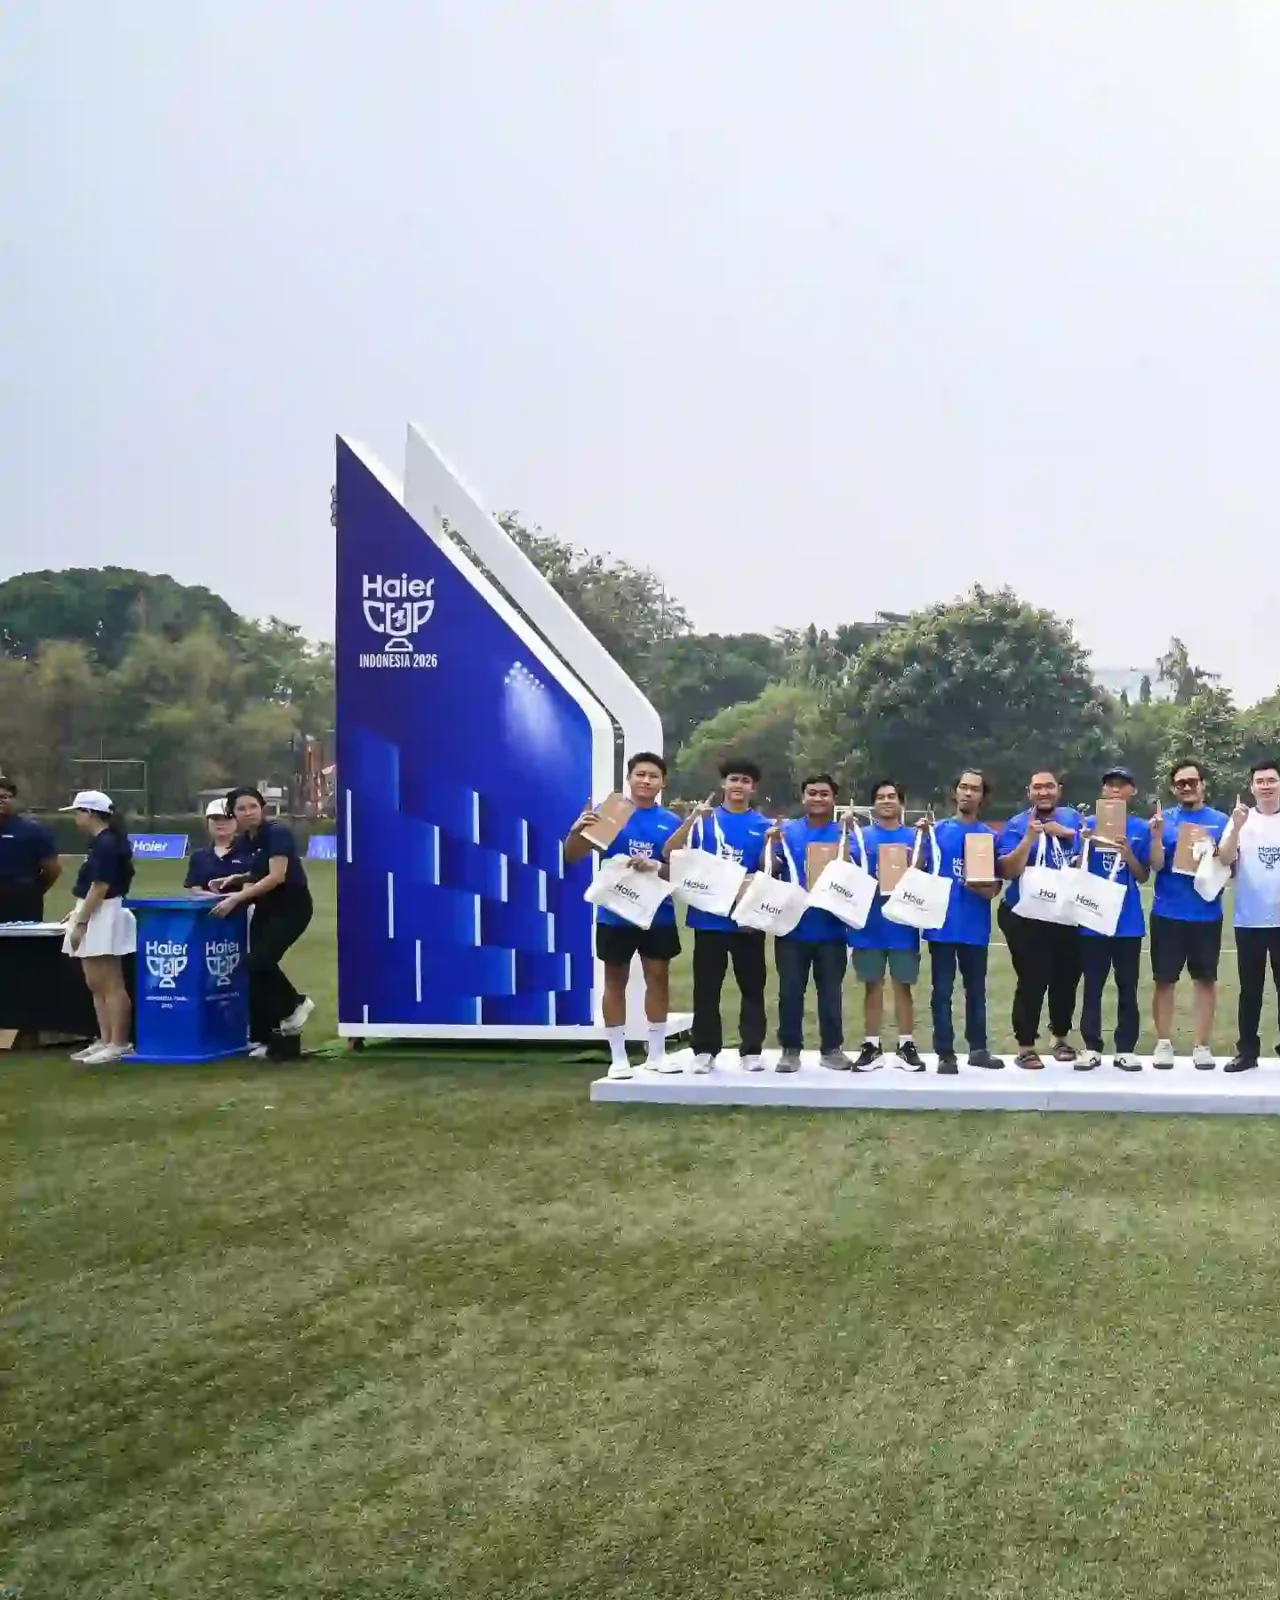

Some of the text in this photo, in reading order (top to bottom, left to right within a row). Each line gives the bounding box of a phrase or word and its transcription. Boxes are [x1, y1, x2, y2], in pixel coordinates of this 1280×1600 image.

[362, 573, 435, 598] Haier
[362, 600, 435, 637] CUP
[359, 653, 438, 669] INDONESIA 2026
[133, 840, 168, 852] Haier
[614, 884, 641, 901] Haier
[683, 879, 709, 891] Haier
[829, 881, 855, 899] Haier
[1039, 889, 1057, 901] Hai
[1076, 893, 1099, 911] Haier
[146, 940, 189, 955] Haier
